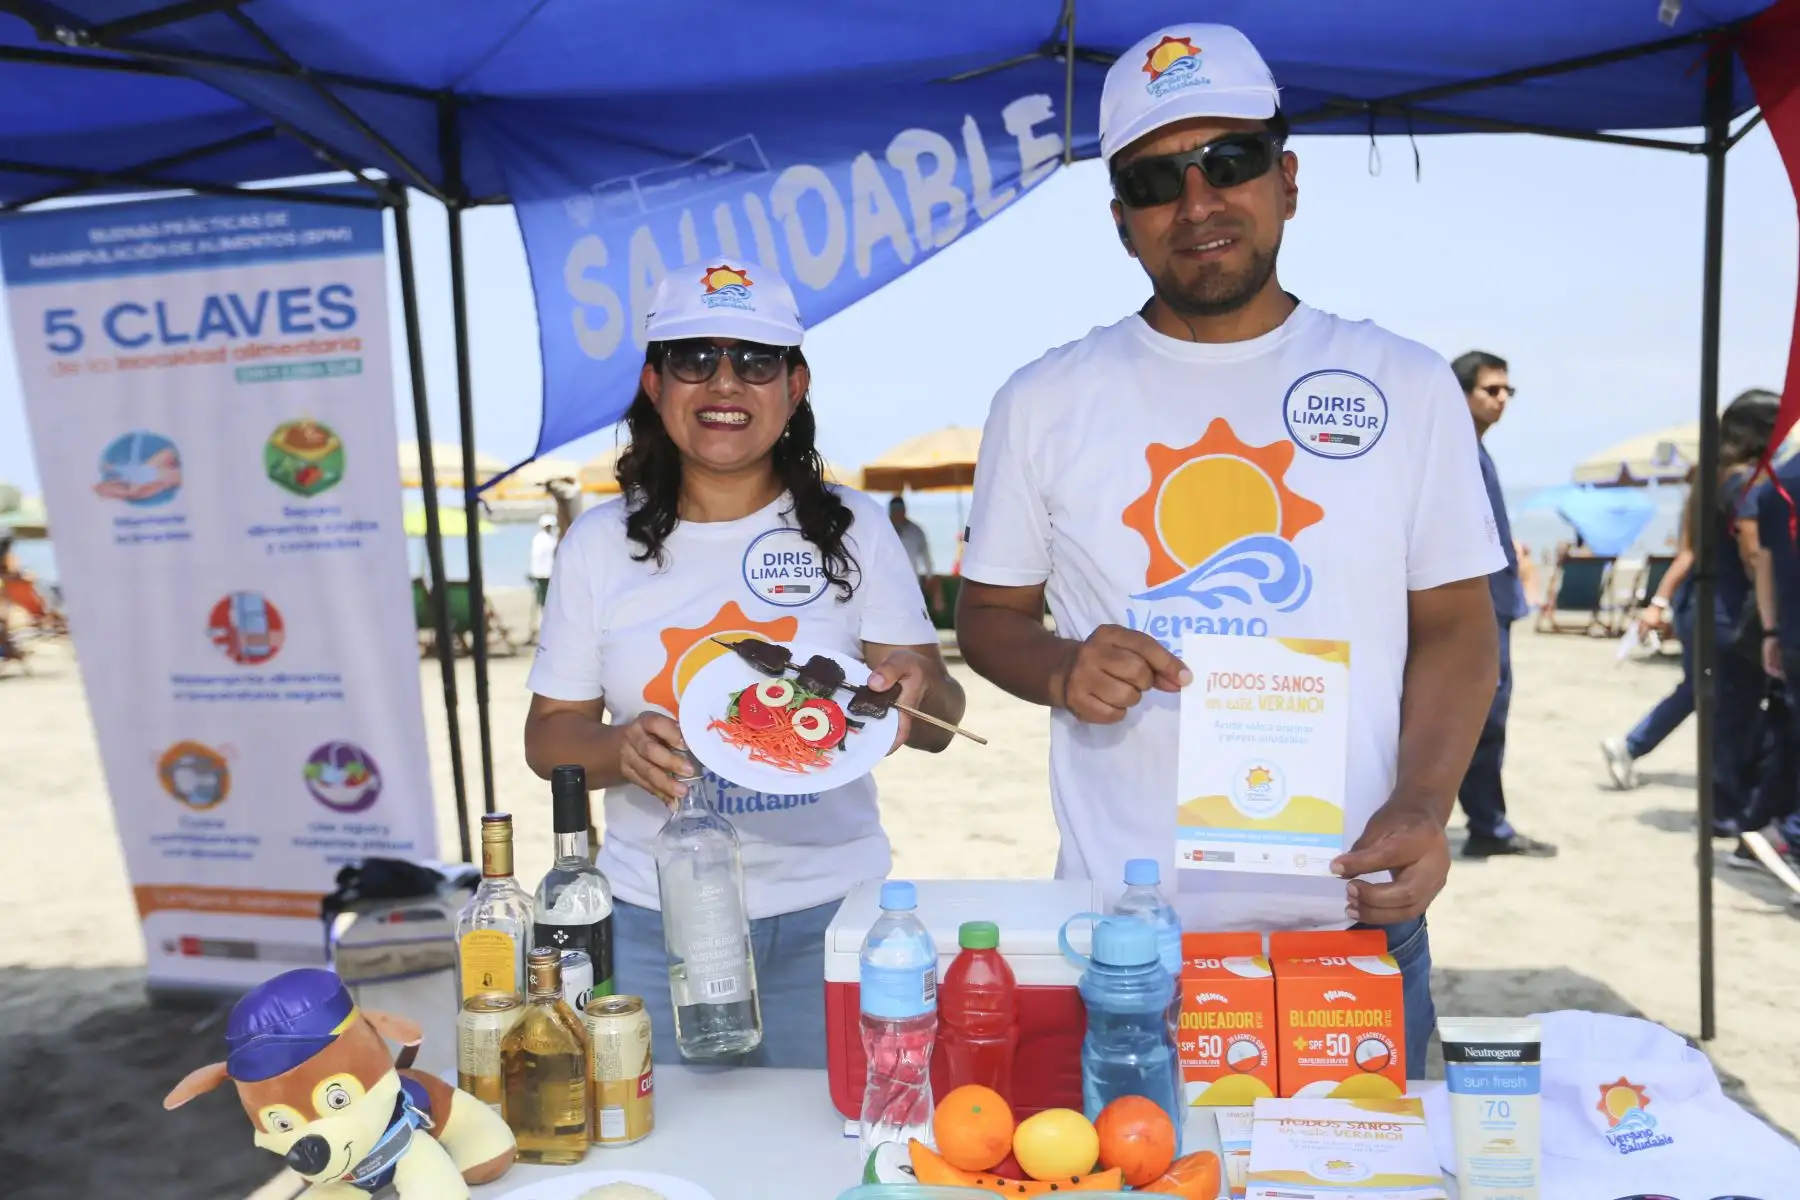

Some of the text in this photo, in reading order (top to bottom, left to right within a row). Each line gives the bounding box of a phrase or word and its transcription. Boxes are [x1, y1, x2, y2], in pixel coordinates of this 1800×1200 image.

[43, 283, 358, 355] 5 CLAVES
[1308, 395, 1366, 412] DIRIS
[1293, 410, 1379, 429] LIMA SUR
[763, 552, 812, 566] DIRIS
[751, 567, 825, 580] LIMA SUR
[1126, 608, 1268, 638] Verano
[1271, 675, 1326, 694] SANOS
[1259, 694, 1324, 713] VERANO!
[1194, 958, 1221, 969] 50
[1318, 956, 1346, 966] 50
[1289, 1009, 1383, 1028] BLOQUEADOR
[1181, 1034, 1223, 1058] SPF 50
[1308, 1040, 1324, 1050] SPF
[1326, 1033, 1351, 1057] 50
[1464, 1047, 1522, 1060] Neutrogena
[1464, 1075, 1527, 1088] sun fresh
[1485, 1101, 1511, 1119] 70
[1346, 1121, 1403, 1132] SANOS
[1606, 1129, 1654, 1147] Verano
[1619, 1134, 1674, 1155] Saludable
